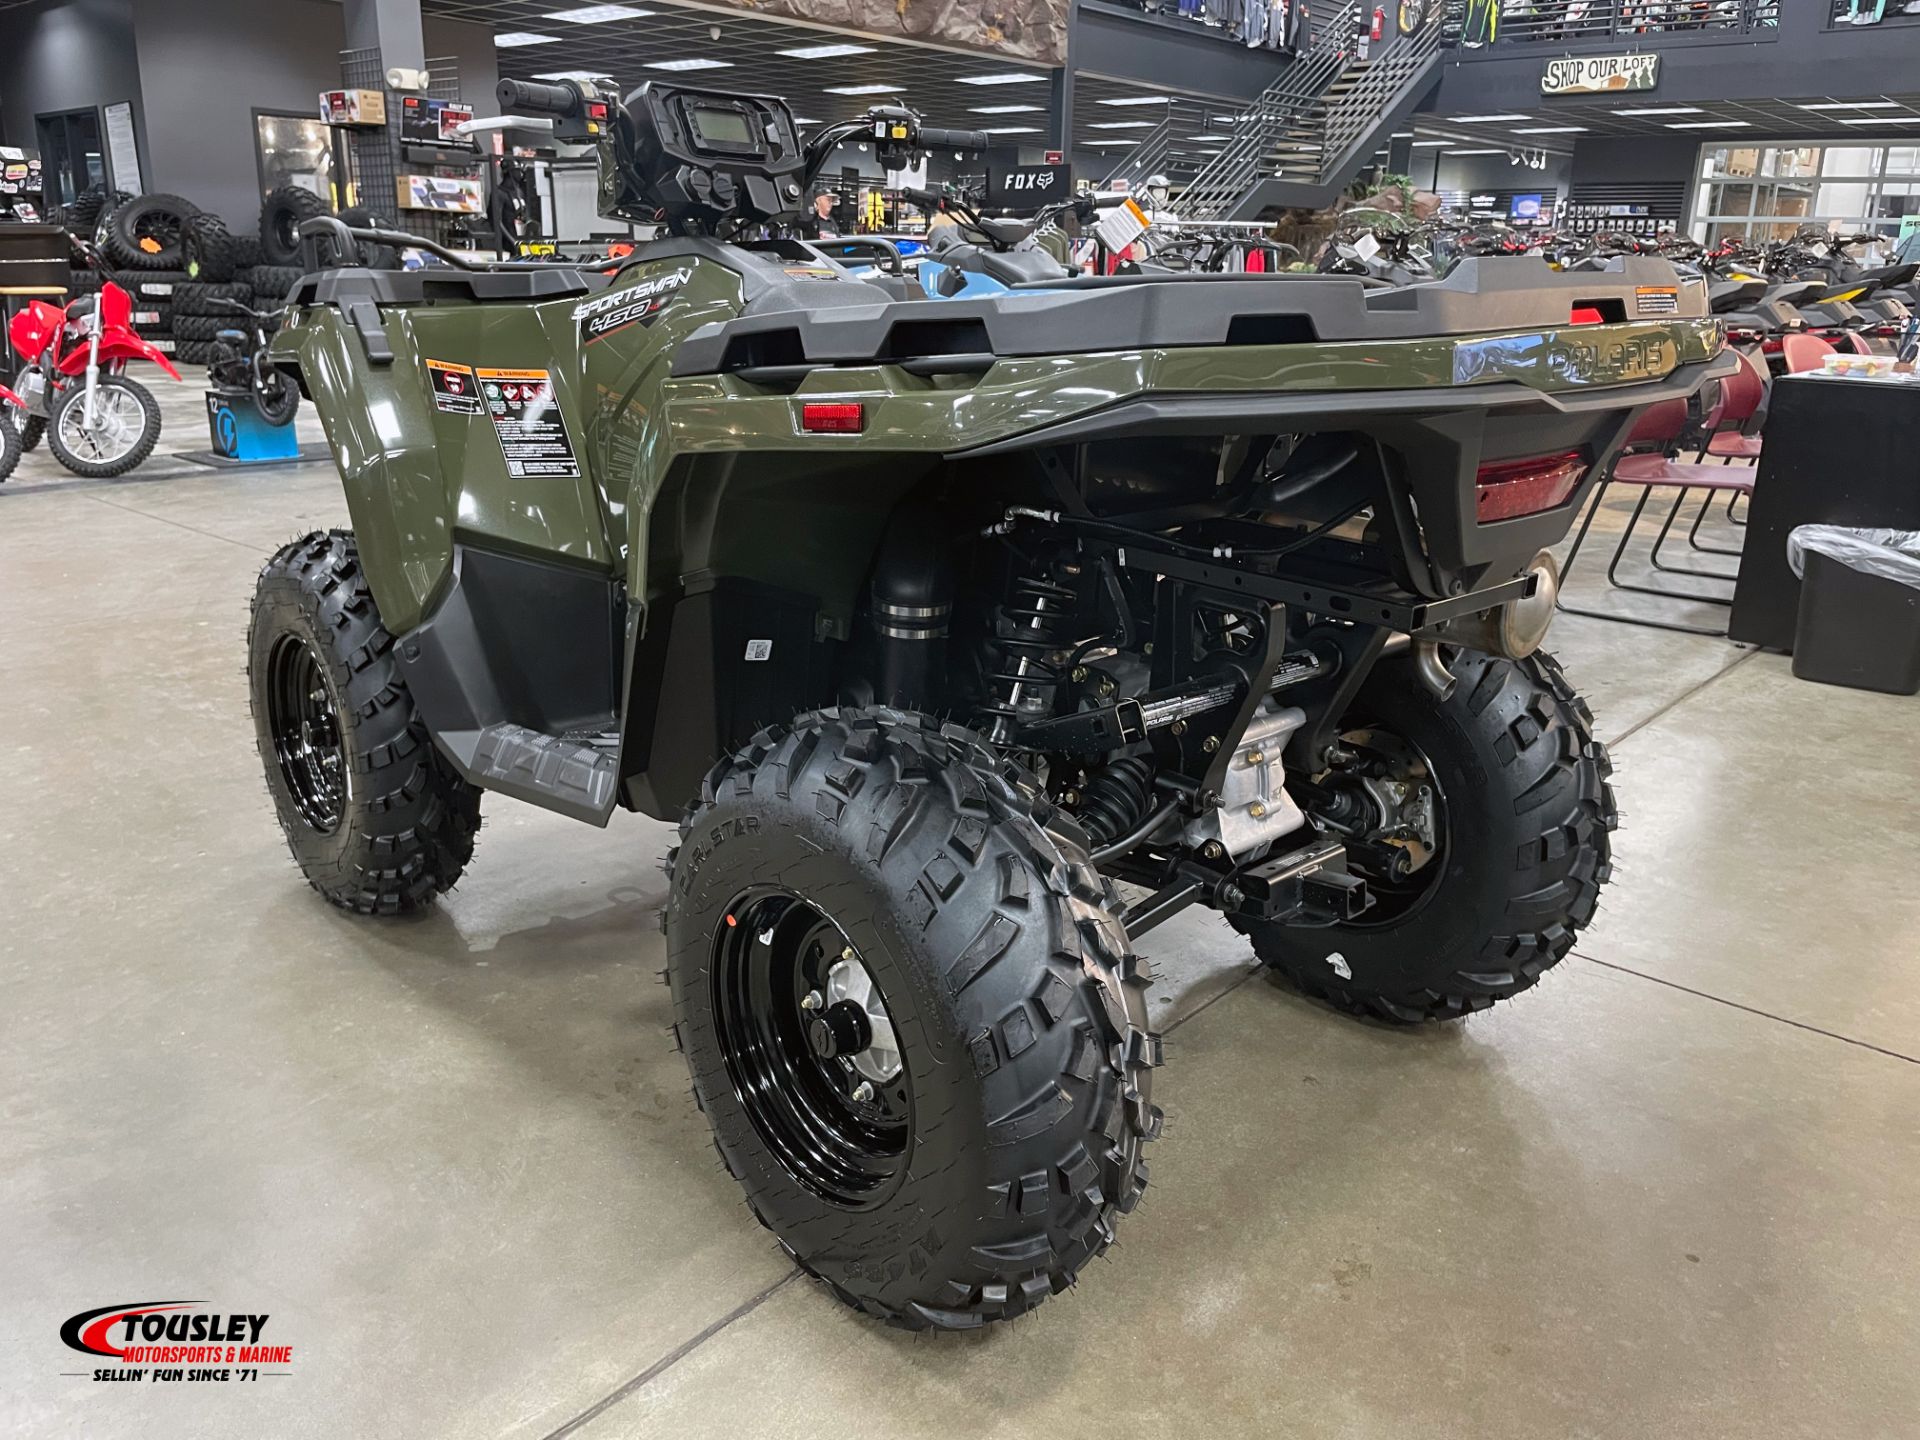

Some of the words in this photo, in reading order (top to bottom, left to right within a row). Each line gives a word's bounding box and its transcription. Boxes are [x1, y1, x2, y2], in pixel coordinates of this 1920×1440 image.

[1544, 61, 1584, 89] SHOP
[1588, 59, 1618, 79] OUR
[1622, 57, 1655, 72] LOFT
[1004, 173, 1036, 190] FOX
[571, 267, 692, 320] SPORTSMAN
[589, 298, 652, 332] 450
[1547, 338, 1664, 382] POLARIS
